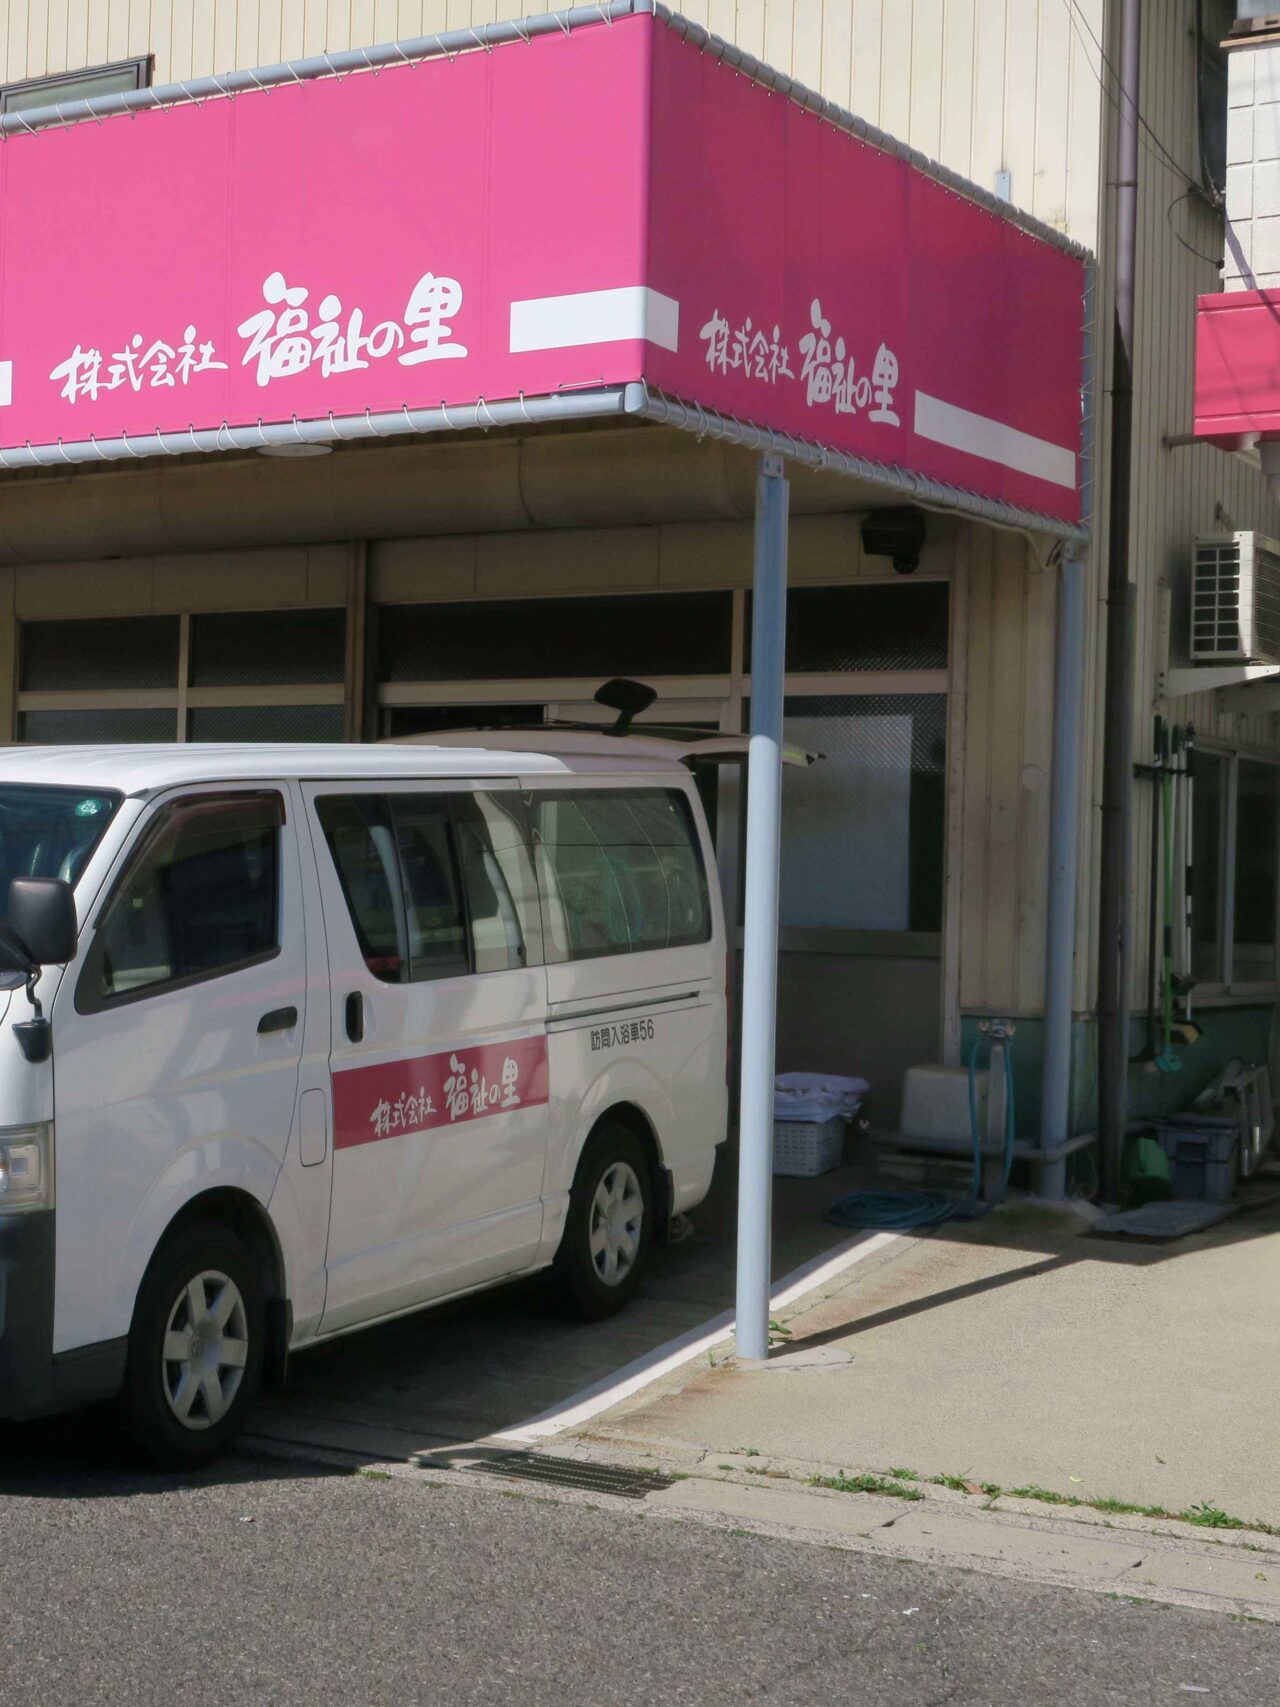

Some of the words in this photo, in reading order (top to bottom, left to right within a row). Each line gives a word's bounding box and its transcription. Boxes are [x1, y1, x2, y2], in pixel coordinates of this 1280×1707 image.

[49, 325, 229, 404] 株式会社
[237, 271, 468, 387] 福祉の里
[699, 308, 795, 385] 株式会社
[799, 298, 901, 427] 福祉の里
[590, 1018, 655, 1051] 訪問入浴車56
[370, 1086, 437, 1137] 株式会社
[443, 1053, 521, 1121] 福祉の里
